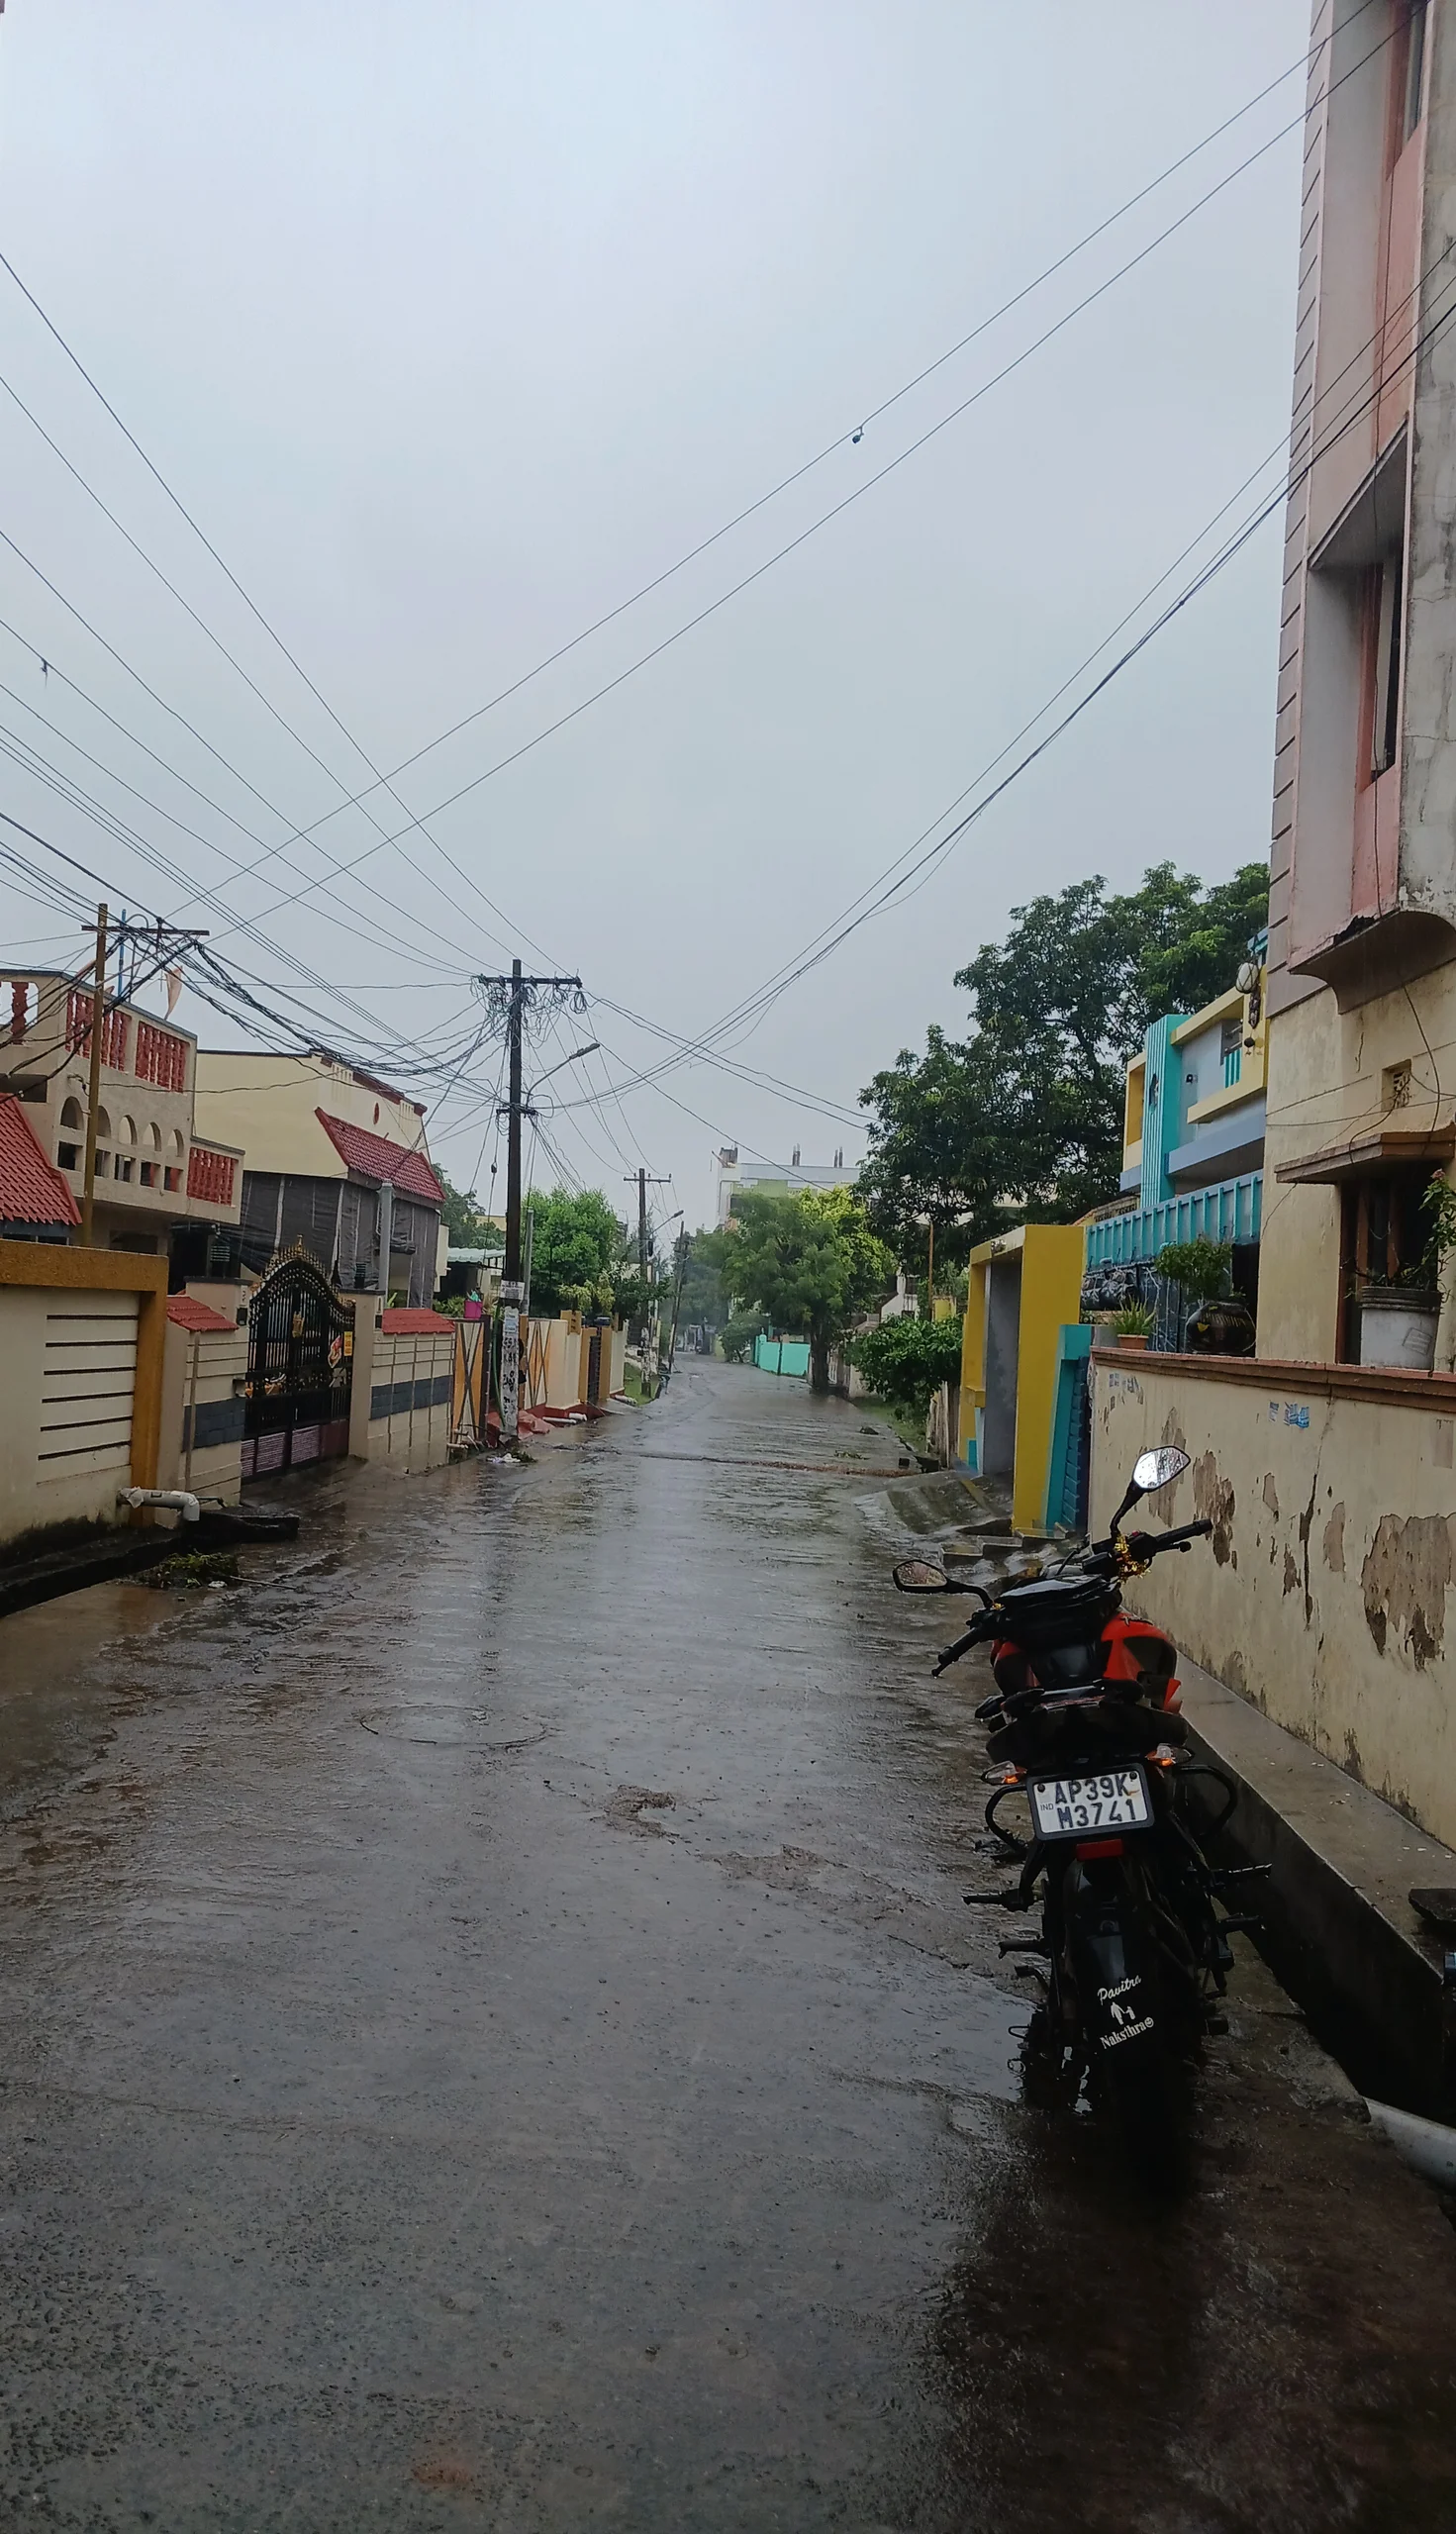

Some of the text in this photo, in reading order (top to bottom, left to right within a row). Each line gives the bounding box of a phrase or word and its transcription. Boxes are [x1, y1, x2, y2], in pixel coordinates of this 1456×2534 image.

[1055, 1774, 1130, 1804] AP39K
[1057, 1798, 1136, 1829] M3741
[1097, 1975, 1141, 2005] Pavitra
[1100, 2021, 1146, 2049] Naksthra
